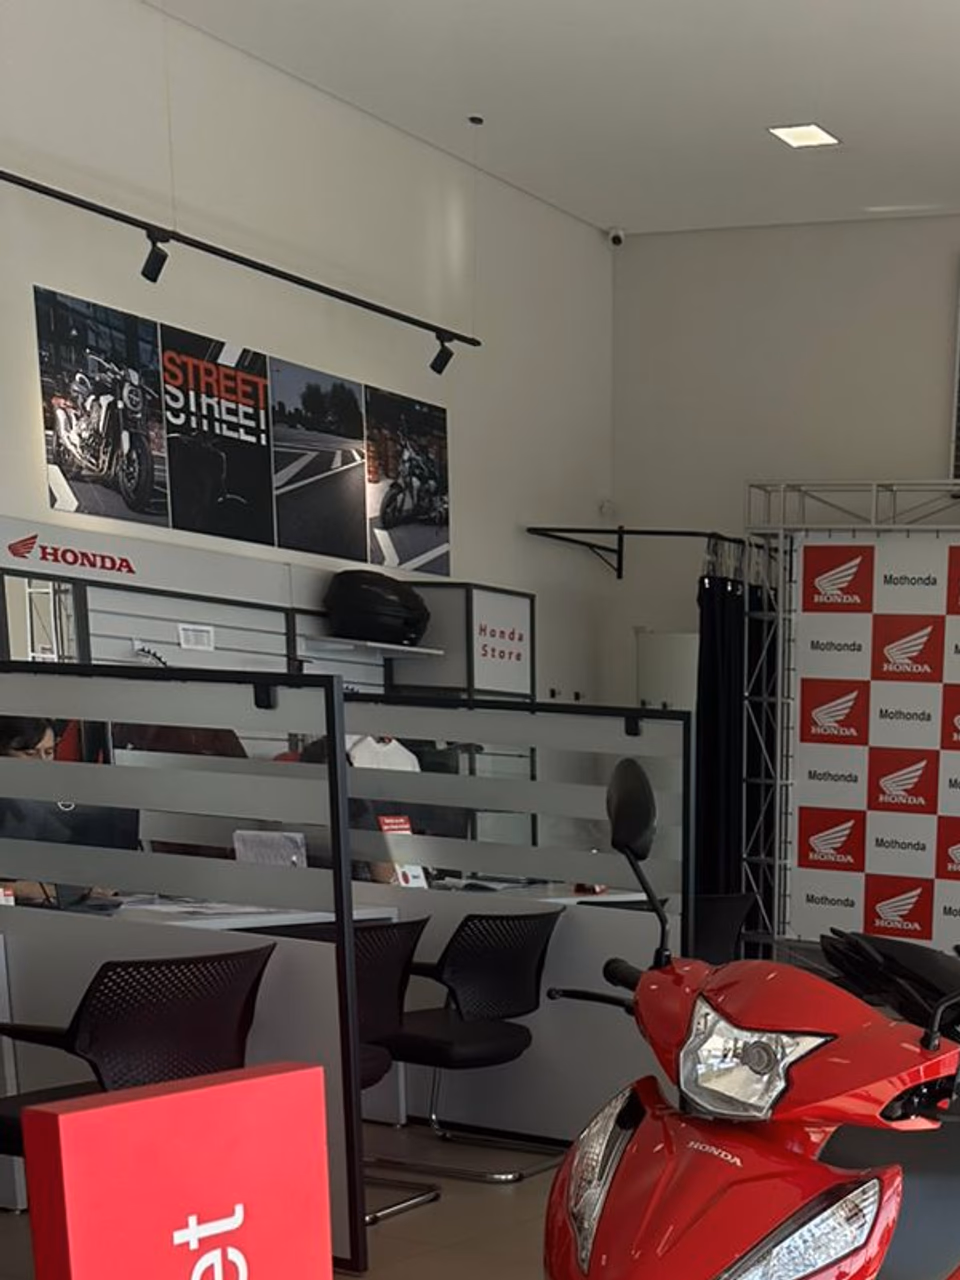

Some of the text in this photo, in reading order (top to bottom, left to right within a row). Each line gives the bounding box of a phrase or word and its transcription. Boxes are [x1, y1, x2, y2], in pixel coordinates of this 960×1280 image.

[163, 350, 268, 411] STREET
[39, 545, 136, 574] HONDA
[884, 574, 937, 586] Mothonda
[814, 594, 861, 603] HONDA
[479, 623, 523, 642] Honda
[481, 643, 522, 662] Store
[811, 640, 862, 652] Mothonda
[883, 663, 931, 672] HONDA
[879, 709, 931, 722] Mothonda
[811, 726, 857, 736] HONDA
[808, 770, 858, 783] Mothonda
[879, 794, 925, 805] HONDA
[875, 838, 926, 851] Mothonda
[809, 852, 854, 863] HONDA
[806, 894, 855, 908] Mothonda
[875, 919, 921, 931] HONDA
[686, 1141, 743, 1168] HONDA
